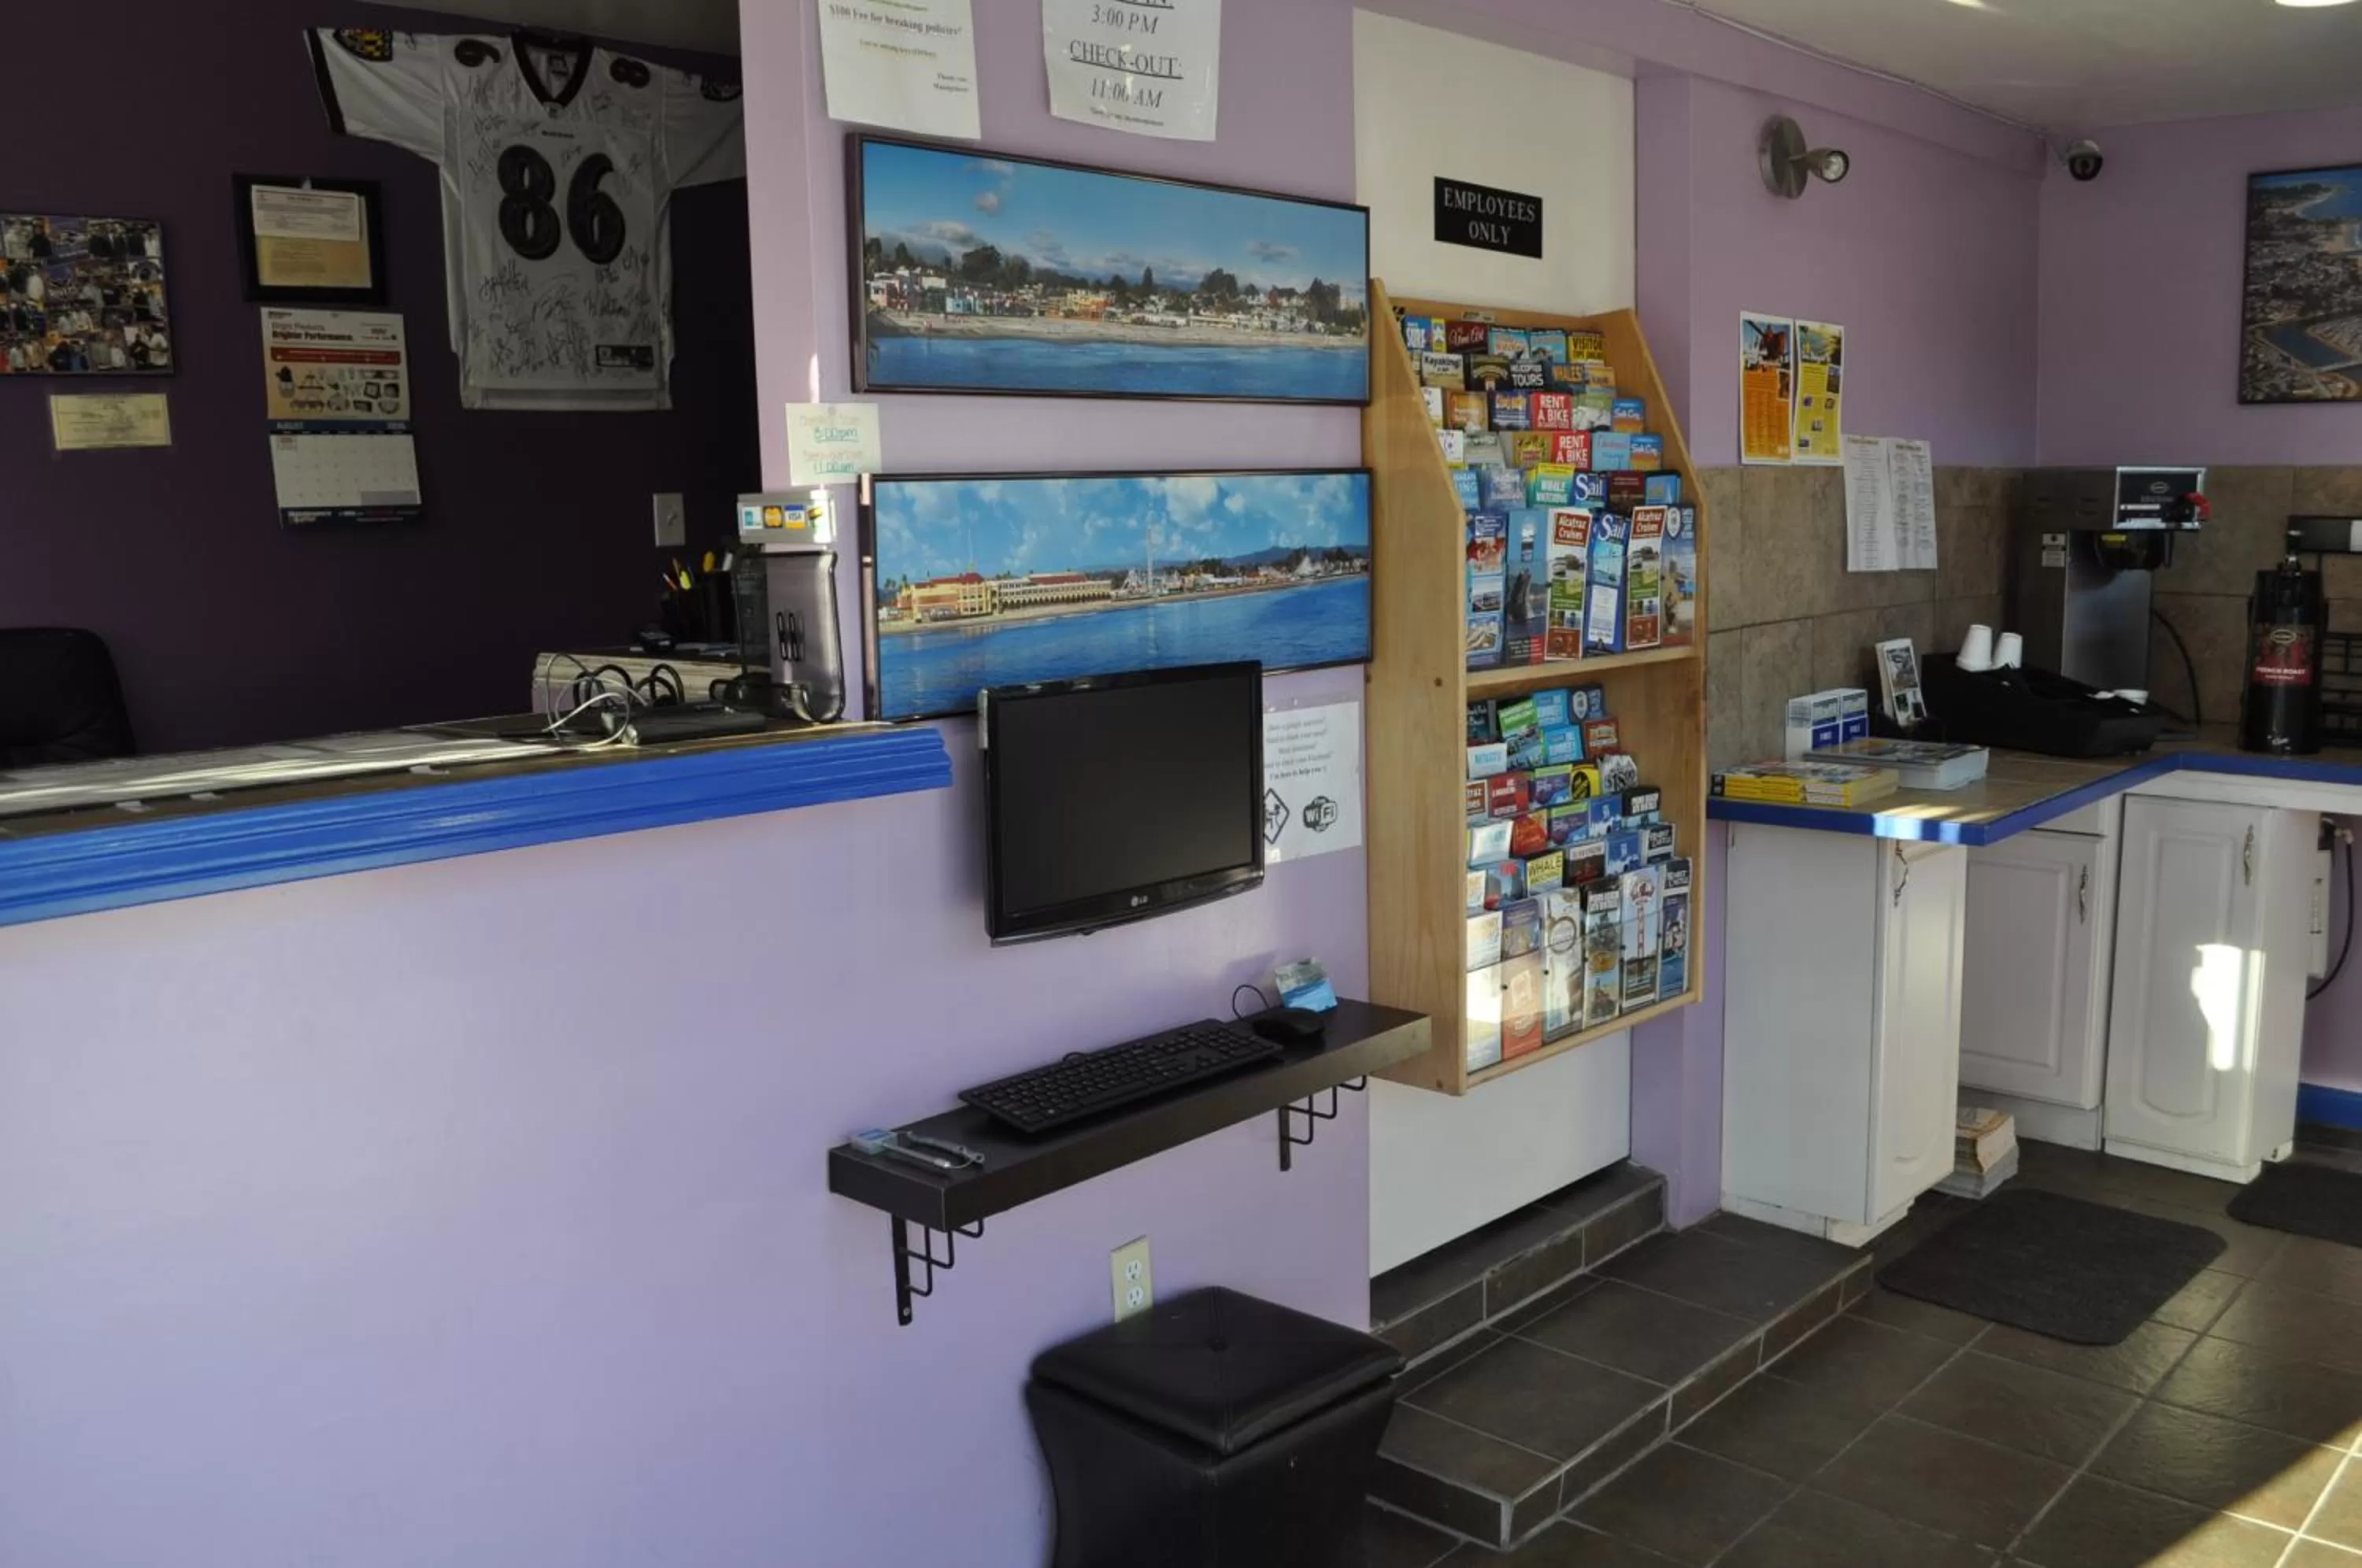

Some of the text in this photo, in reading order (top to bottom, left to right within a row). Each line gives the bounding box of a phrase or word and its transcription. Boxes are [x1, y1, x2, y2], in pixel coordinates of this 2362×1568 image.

[1091, 4, 1160, 35] 3:00 PM
[1134, 87, 1163, 109] AM
[496, 145, 626, 264] 86
[1443, 186, 1536, 224] EMPLOYEES
[1468, 220, 1512, 246] ONLY
[1511, 373, 1544, 387] TOURS
[1539, 394, 1565, 409] RENT
[1537, 409, 1569, 423] A BIKE
[1559, 435, 1585, 449] RENT
[1565, 449, 1589, 463] BIKE
[1575, 473, 1603, 501] Sail
[1598, 513, 1627, 541] Sail
